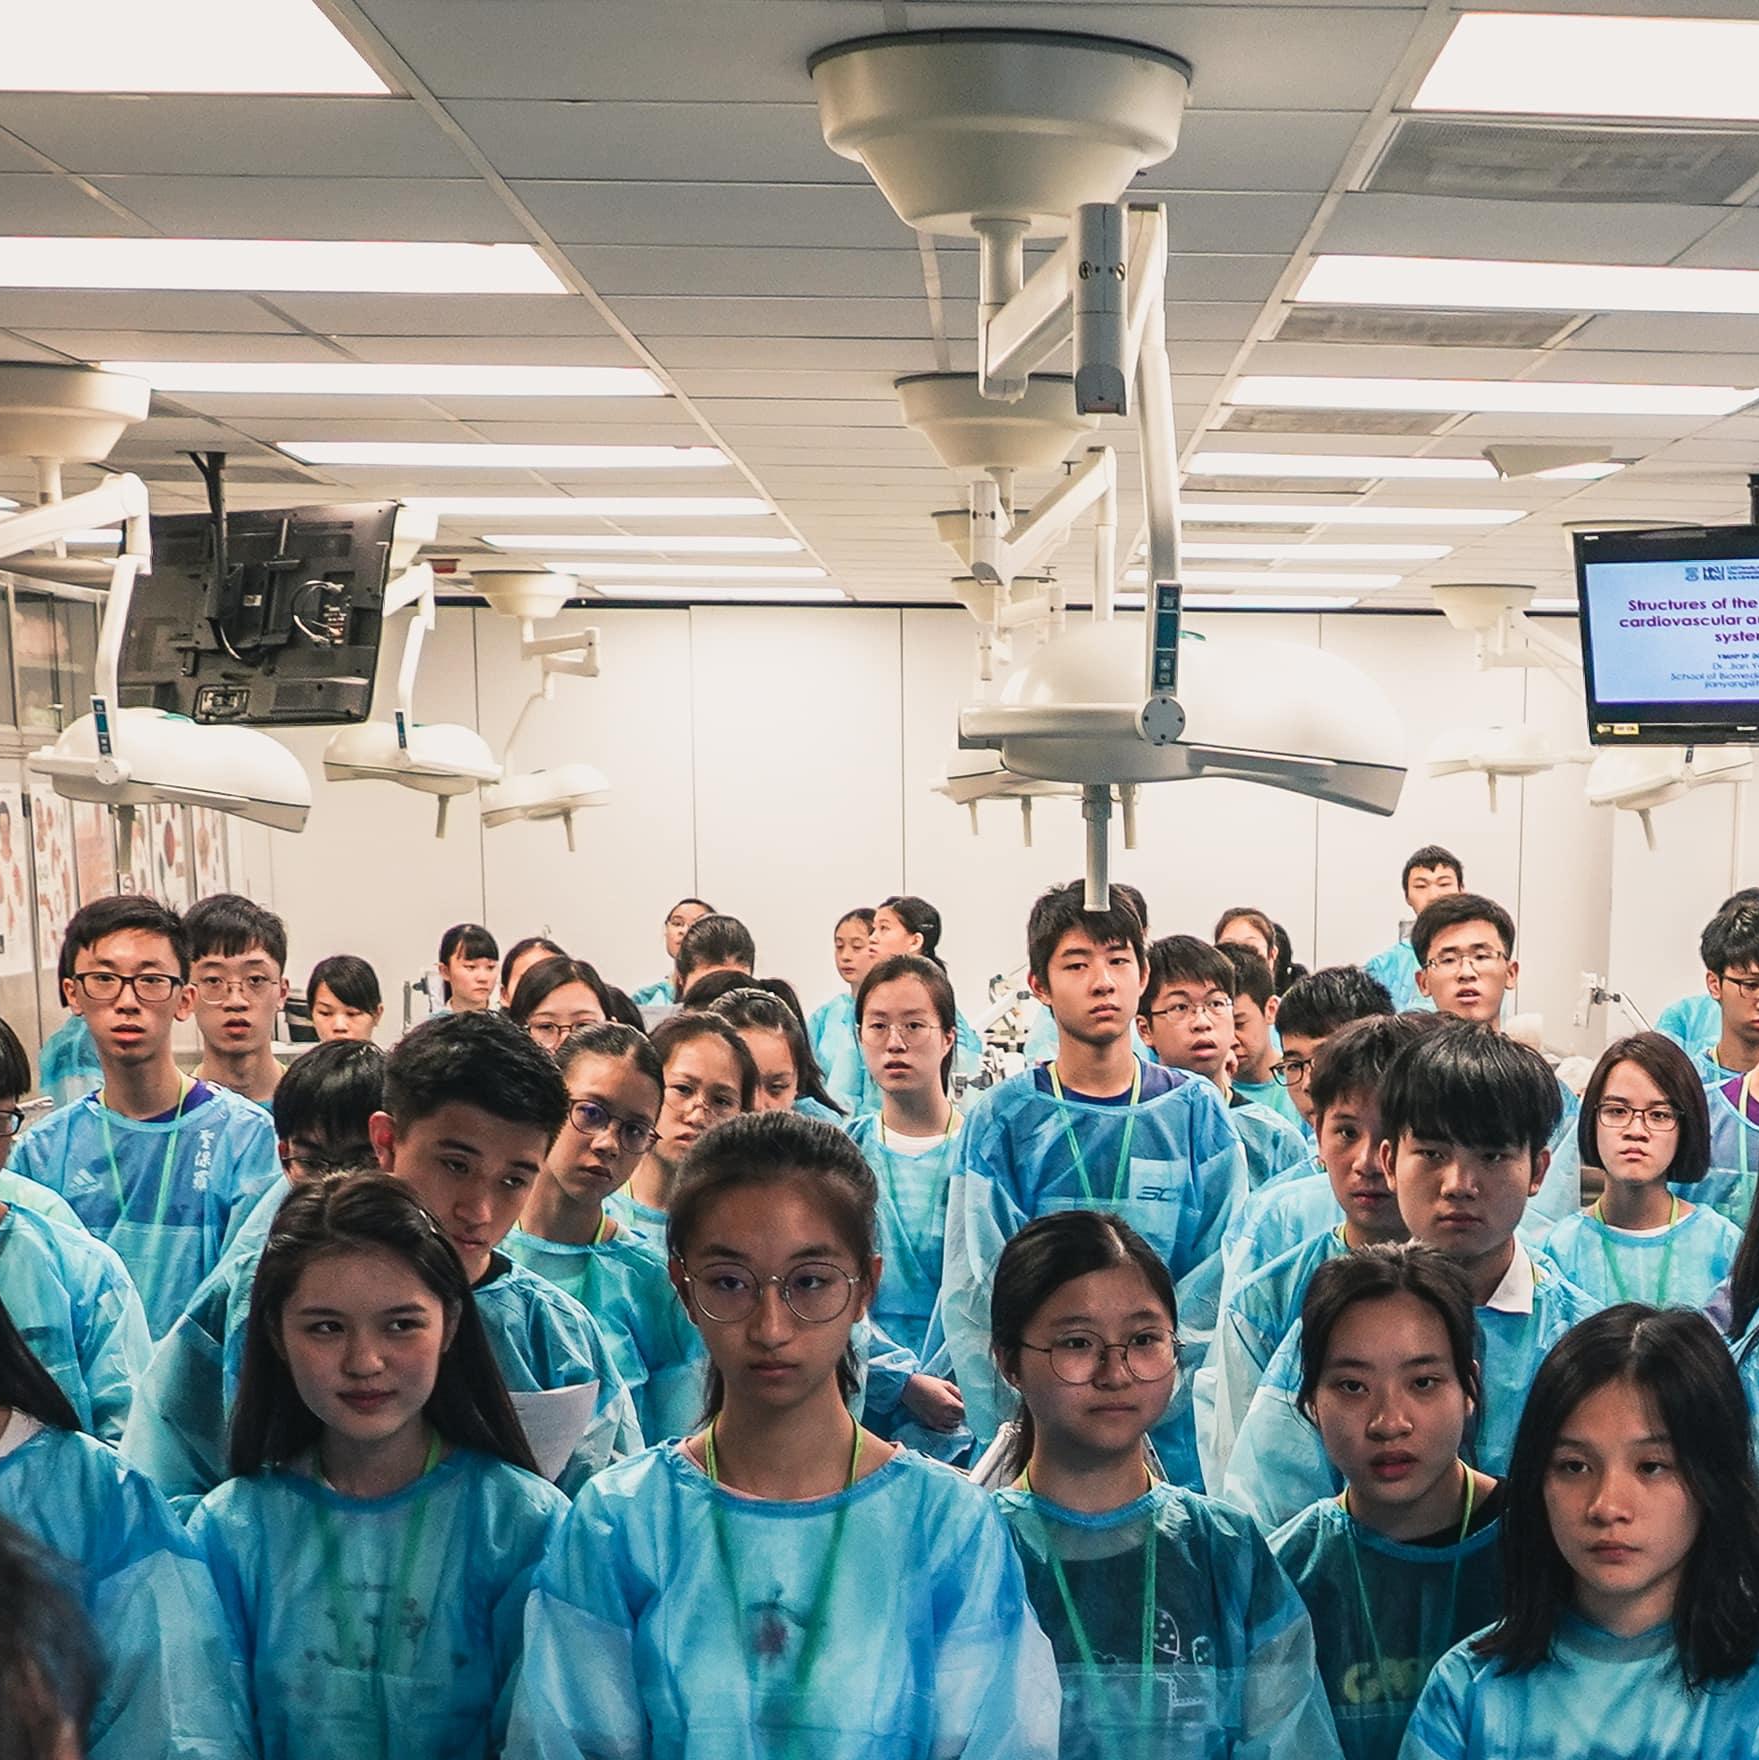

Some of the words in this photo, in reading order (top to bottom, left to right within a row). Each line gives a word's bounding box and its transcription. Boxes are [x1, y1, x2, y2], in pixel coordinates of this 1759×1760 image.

[1628, 599, 1707, 612] Structures
[1711, 598, 1727, 609] of
[1732, 597, 1758, 609] the
[1619, 615, 1742, 628] cardiovascular
[1671, 672, 1705, 680] School
